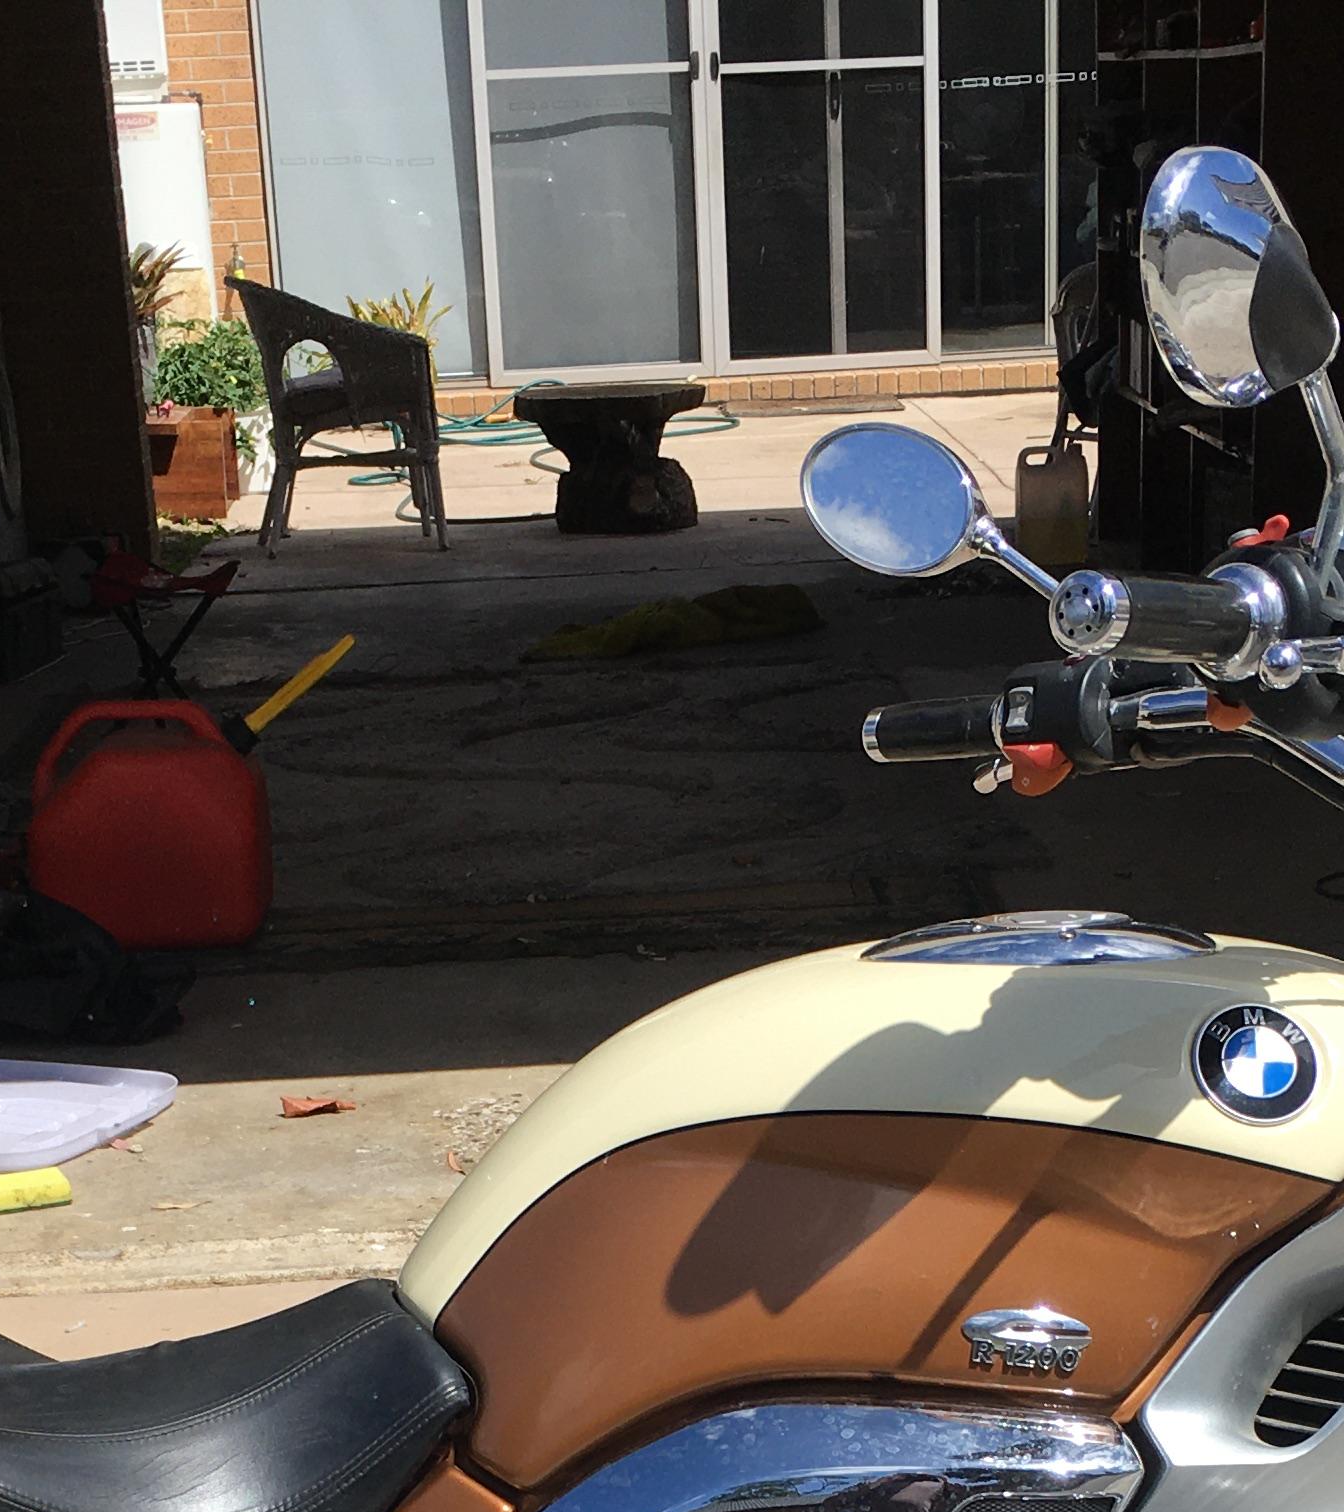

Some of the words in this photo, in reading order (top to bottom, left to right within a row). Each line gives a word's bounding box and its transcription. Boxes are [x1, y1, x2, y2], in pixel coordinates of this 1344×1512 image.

[1207, 1008, 1305, 1045] BMW
[971, 1338, 994, 1364] R
[1004, 1341, 1080, 1372] 1200
